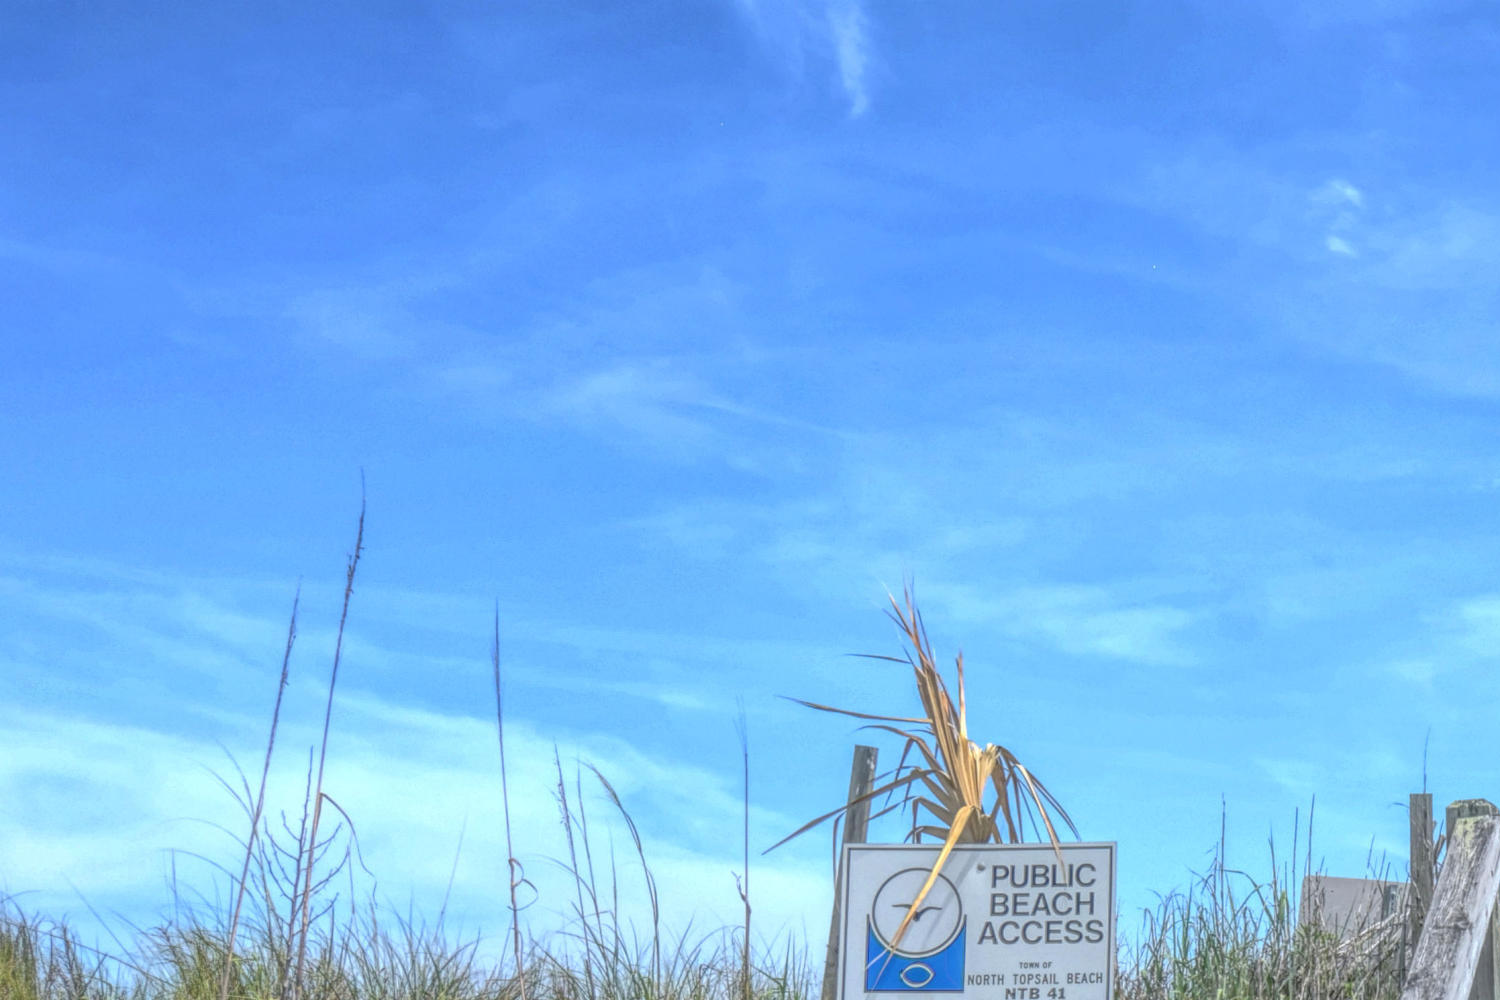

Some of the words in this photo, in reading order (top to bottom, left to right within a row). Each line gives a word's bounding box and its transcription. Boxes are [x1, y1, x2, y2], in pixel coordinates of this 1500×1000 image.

[991, 863, 1096, 888] PUBLIC
[990, 892, 1094, 916] BEACH
[977, 920, 1103, 944] ACCESS
[968, 974, 1004, 986] NORTH
[1013, 973, 1059, 985] TOPSAIL
[1067, 972, 1103, 984] BEACH
[1005, 988, 1040, 1000] NTB
[1047, 988, 1066, 999] 41
